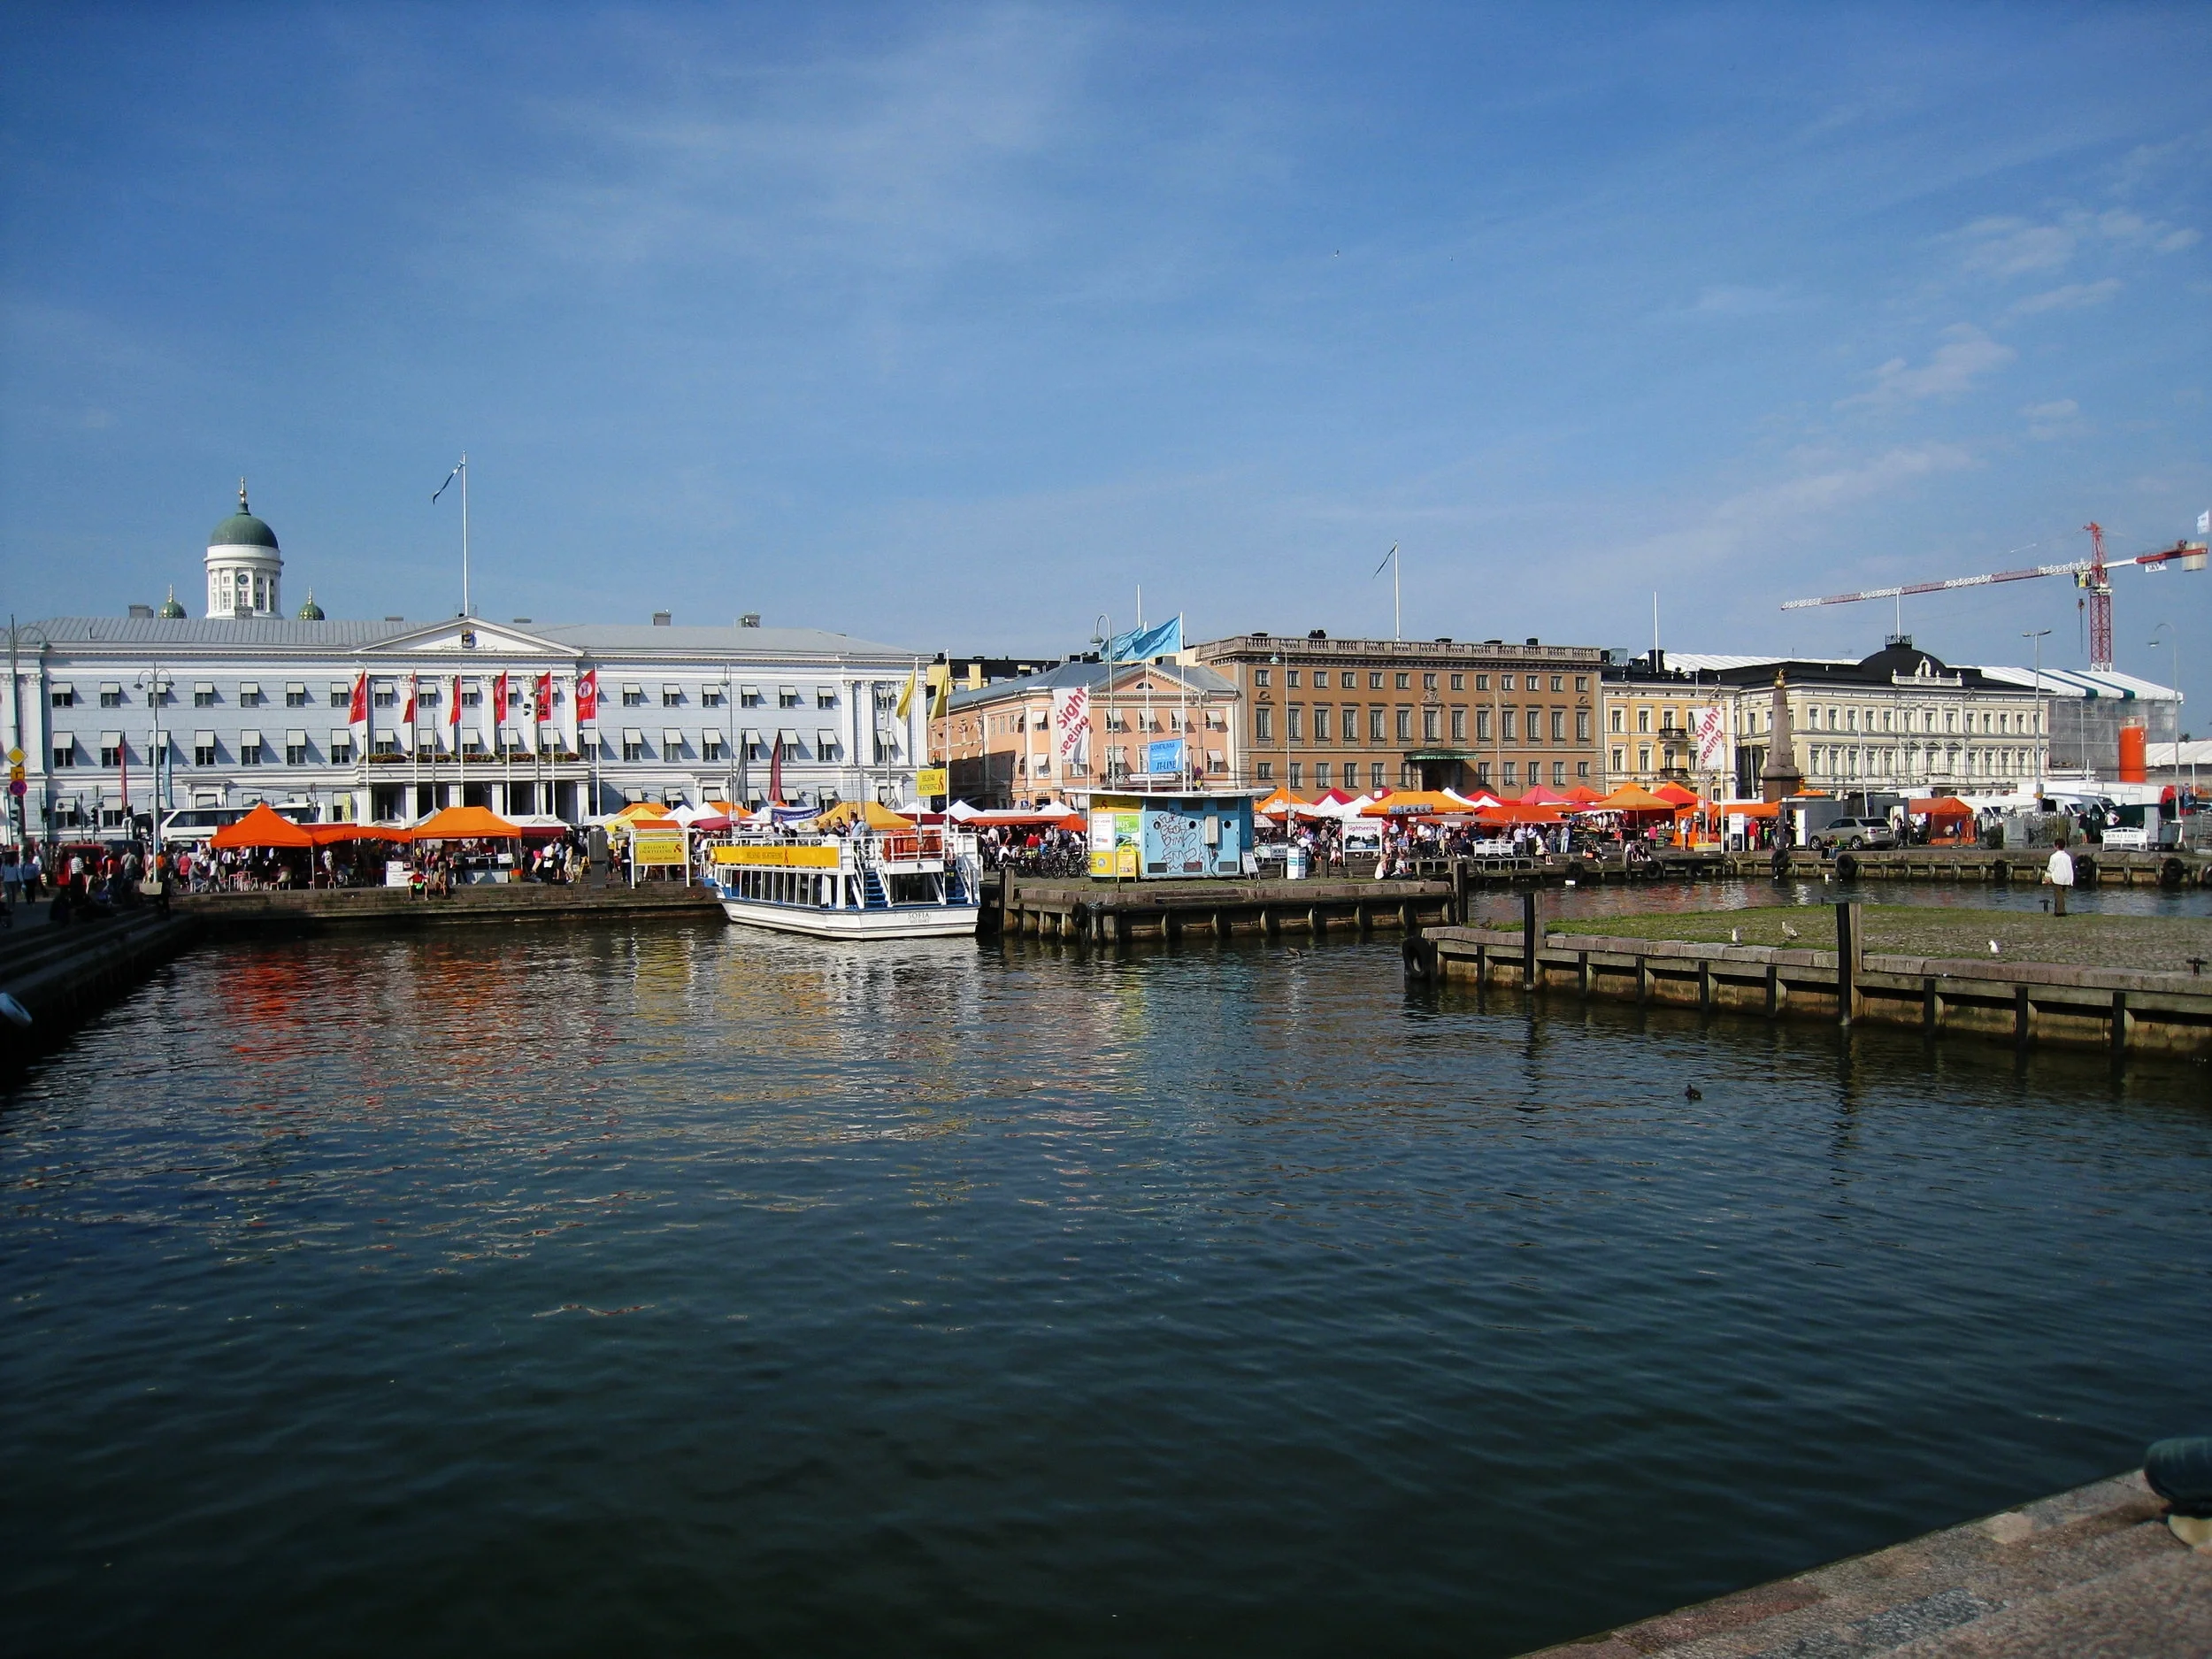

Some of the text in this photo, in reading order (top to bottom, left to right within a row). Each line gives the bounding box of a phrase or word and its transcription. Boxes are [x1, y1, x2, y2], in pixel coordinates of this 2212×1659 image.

[1056, 687, 1087, 730] Sight
[1696, 707, 1721, 742] Sight
[1060, 715, 1089, 757] seeing
[1700, 729, 1724, 765] seeing
